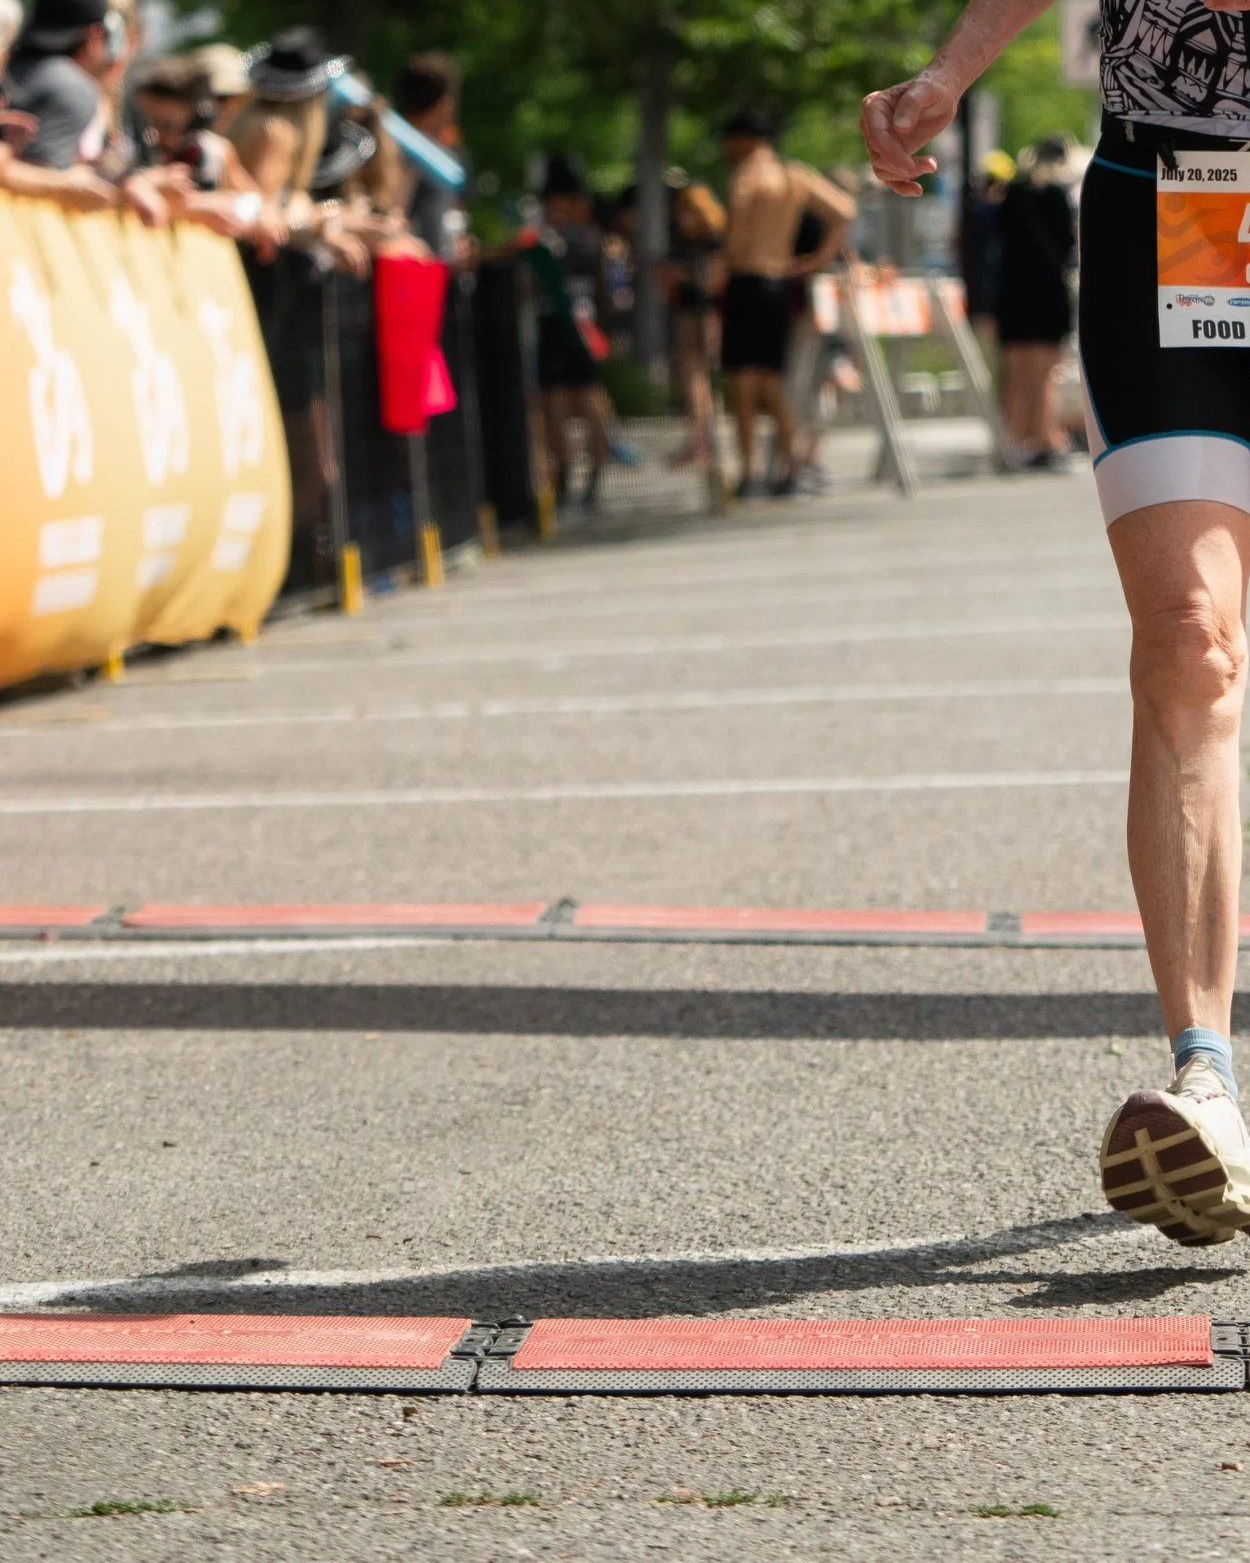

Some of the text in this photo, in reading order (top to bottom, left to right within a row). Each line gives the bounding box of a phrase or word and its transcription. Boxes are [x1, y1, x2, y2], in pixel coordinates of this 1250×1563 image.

[1161, 167, 1238, 182] July 20, 2025
[1192, 319, 1246, 340] FOOD
